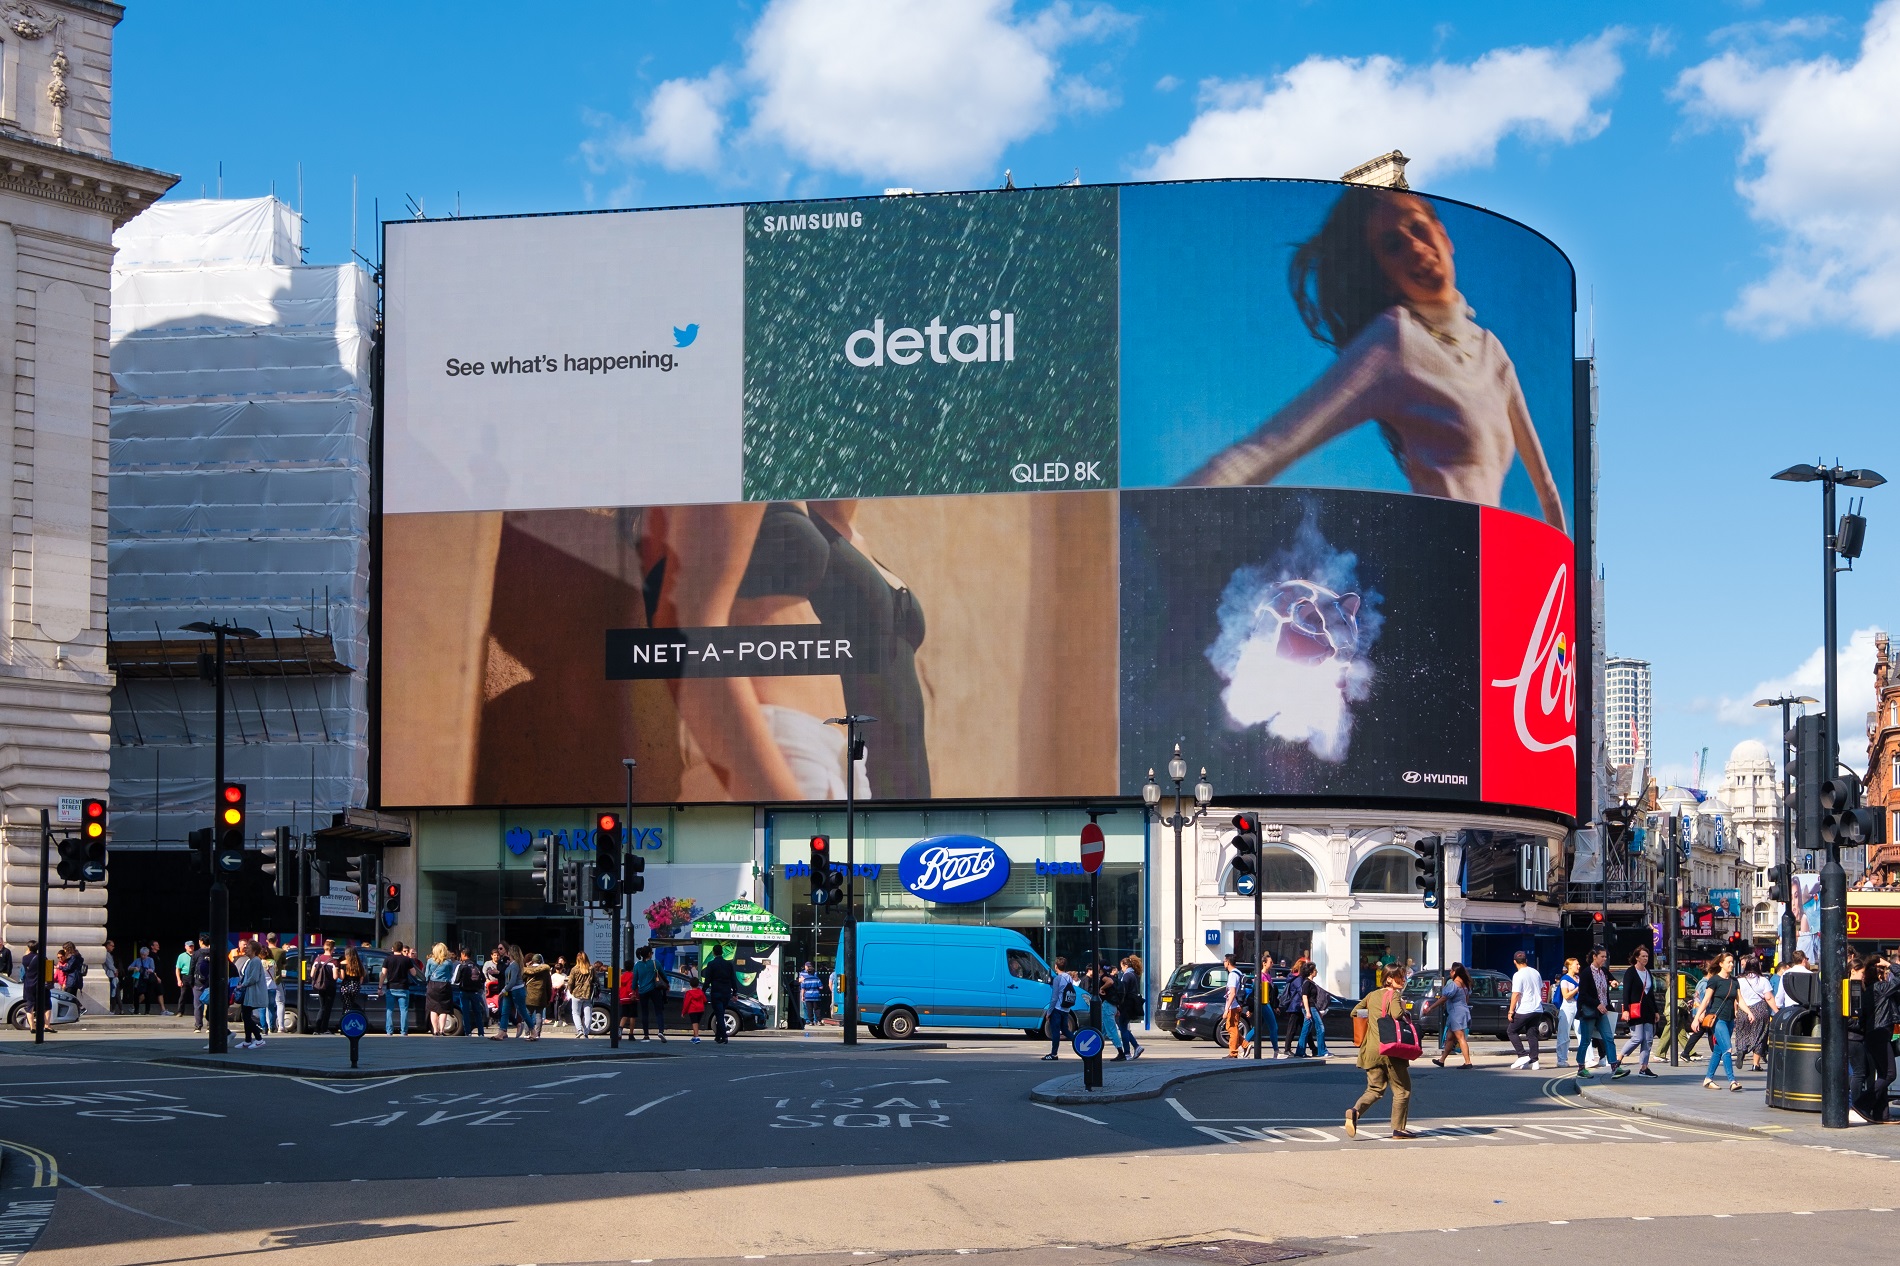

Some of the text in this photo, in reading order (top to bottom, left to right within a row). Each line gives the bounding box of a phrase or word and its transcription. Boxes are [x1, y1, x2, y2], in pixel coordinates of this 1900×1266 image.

[764, 211, 863, 232] SAMSUNG
[845, 309, 1015, 367] detail
[446, 350, 679, 376] See what's happening.
[1012, 461, 1101, 483] QLED 8K
[633, 639, 854, 663] NET-A-PORTER
[1423, 773, 1468, 785] HYUNDAI
[910, 846, 996, 891] Boots
[1520, 843, 1551, 892] GAP
[595, 922, 612, 930] Switc
[0, 1089, 186, 1108] GNT
[76, 1105, 228, 1122] ST
[330, 1110, 551, 1126] AVE
[769, 1113, 953, 1128] SQR
[1192, 1125, 1340, 1144] NO
